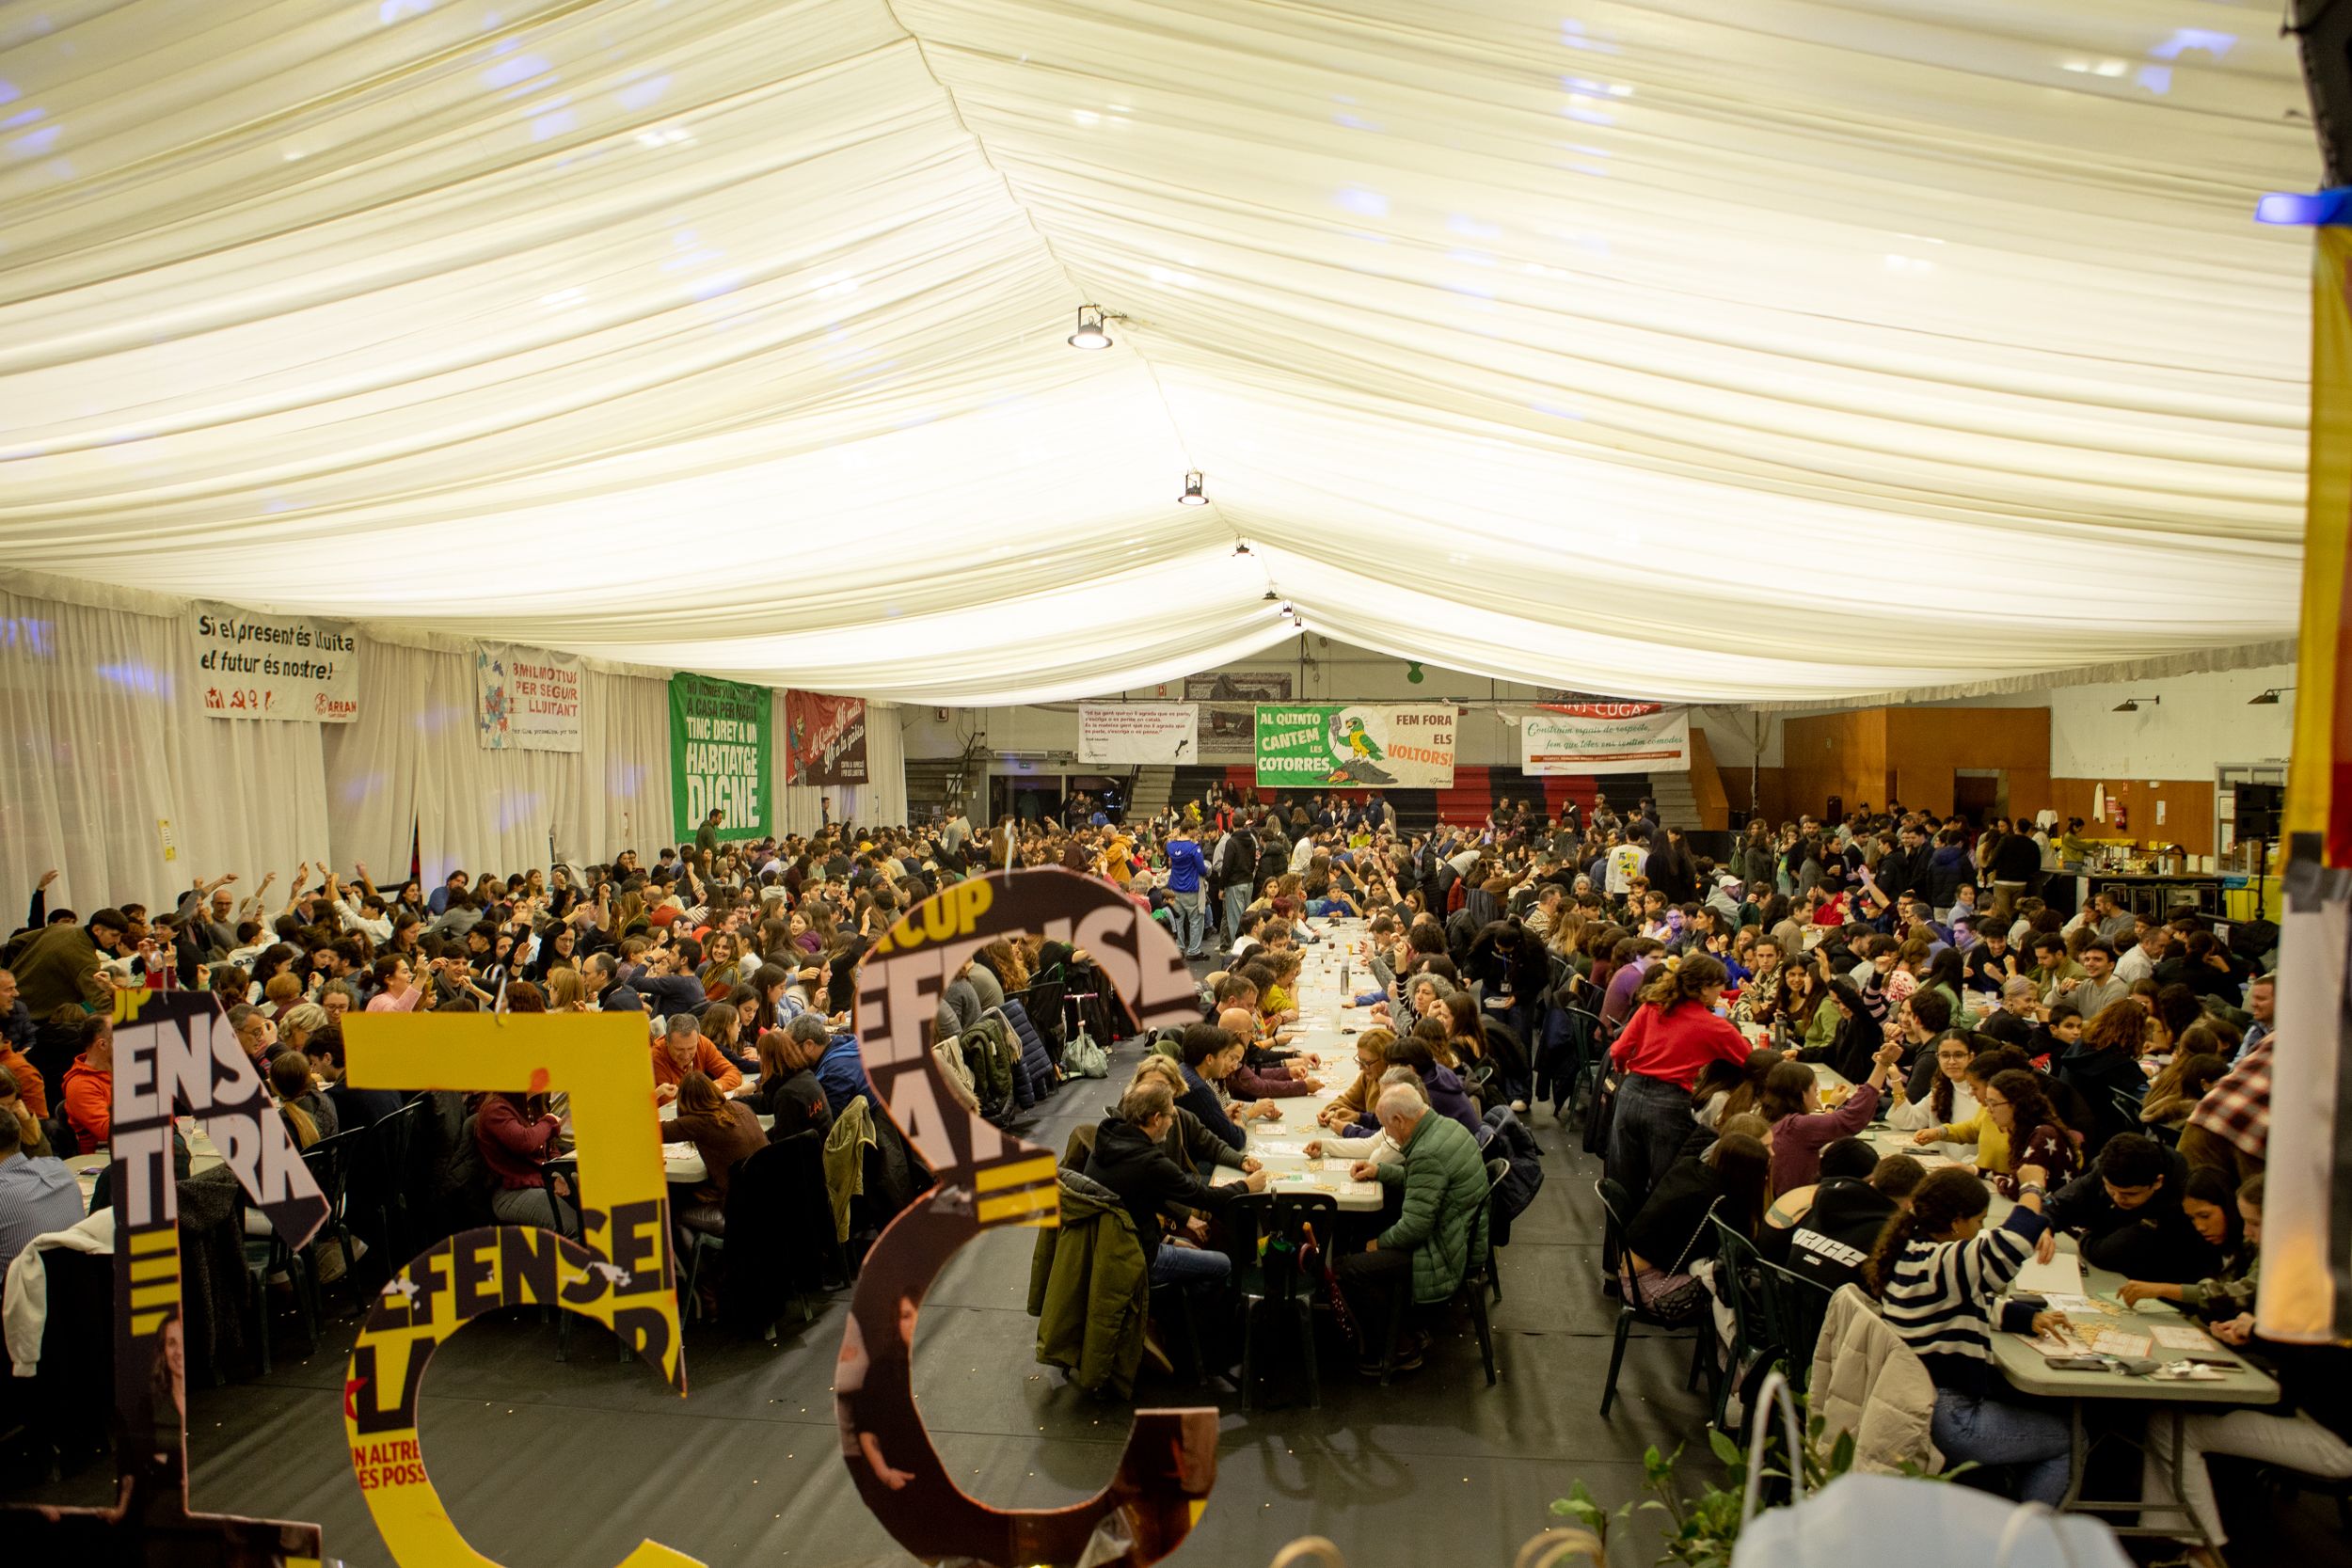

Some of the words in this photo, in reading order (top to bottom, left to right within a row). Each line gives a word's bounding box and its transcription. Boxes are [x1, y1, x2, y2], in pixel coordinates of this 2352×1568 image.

[199, 615, 215, 636] Si
[220, 619, 235, 639] el
[238, 623, 294, 644] present
[296, 626, 311, 647] és
[315, 630, 355, 654] lluita,
[200, 650, 216, 670] el
[221, 651, 261, 673] futur
[263, 653, 279, 675] és
[283, 660, 333, 680] nostre!
[516, 681, 536, 696] PER
[540, 683, 578, 701] SEGUIR
[529, 700, 578, 717] LLUITANT
[687, 698, 693, 716] A
[696, 698, 717, 717] CASA
[721, 701, 735, 719] PER
[686, 716, 710, 740] TINC
[713, 719, 738, 742] DRET
[739, 721, 745, 743] A
[747, 722, 758, 744] UN
[1260, 714, 1274, 725] AL
[1277, 714, 1321, 725] QUINTO
[1396, 715, 1420, 725] FEM
[1422, 715, 1453, 726] FORA
[1262, 728, 1319, 752] CANTEM
[1311, 745, 1323, 753] LES
[1433, 734, 1453, 745] ELS
[686, 743, 758, 776] HABITATGE
[1259, 757, 1335, 773] COTORRES,
[1388, 744, 1454, 768] VOLTORS!
[687, 774, 760, 831] DIGNE
